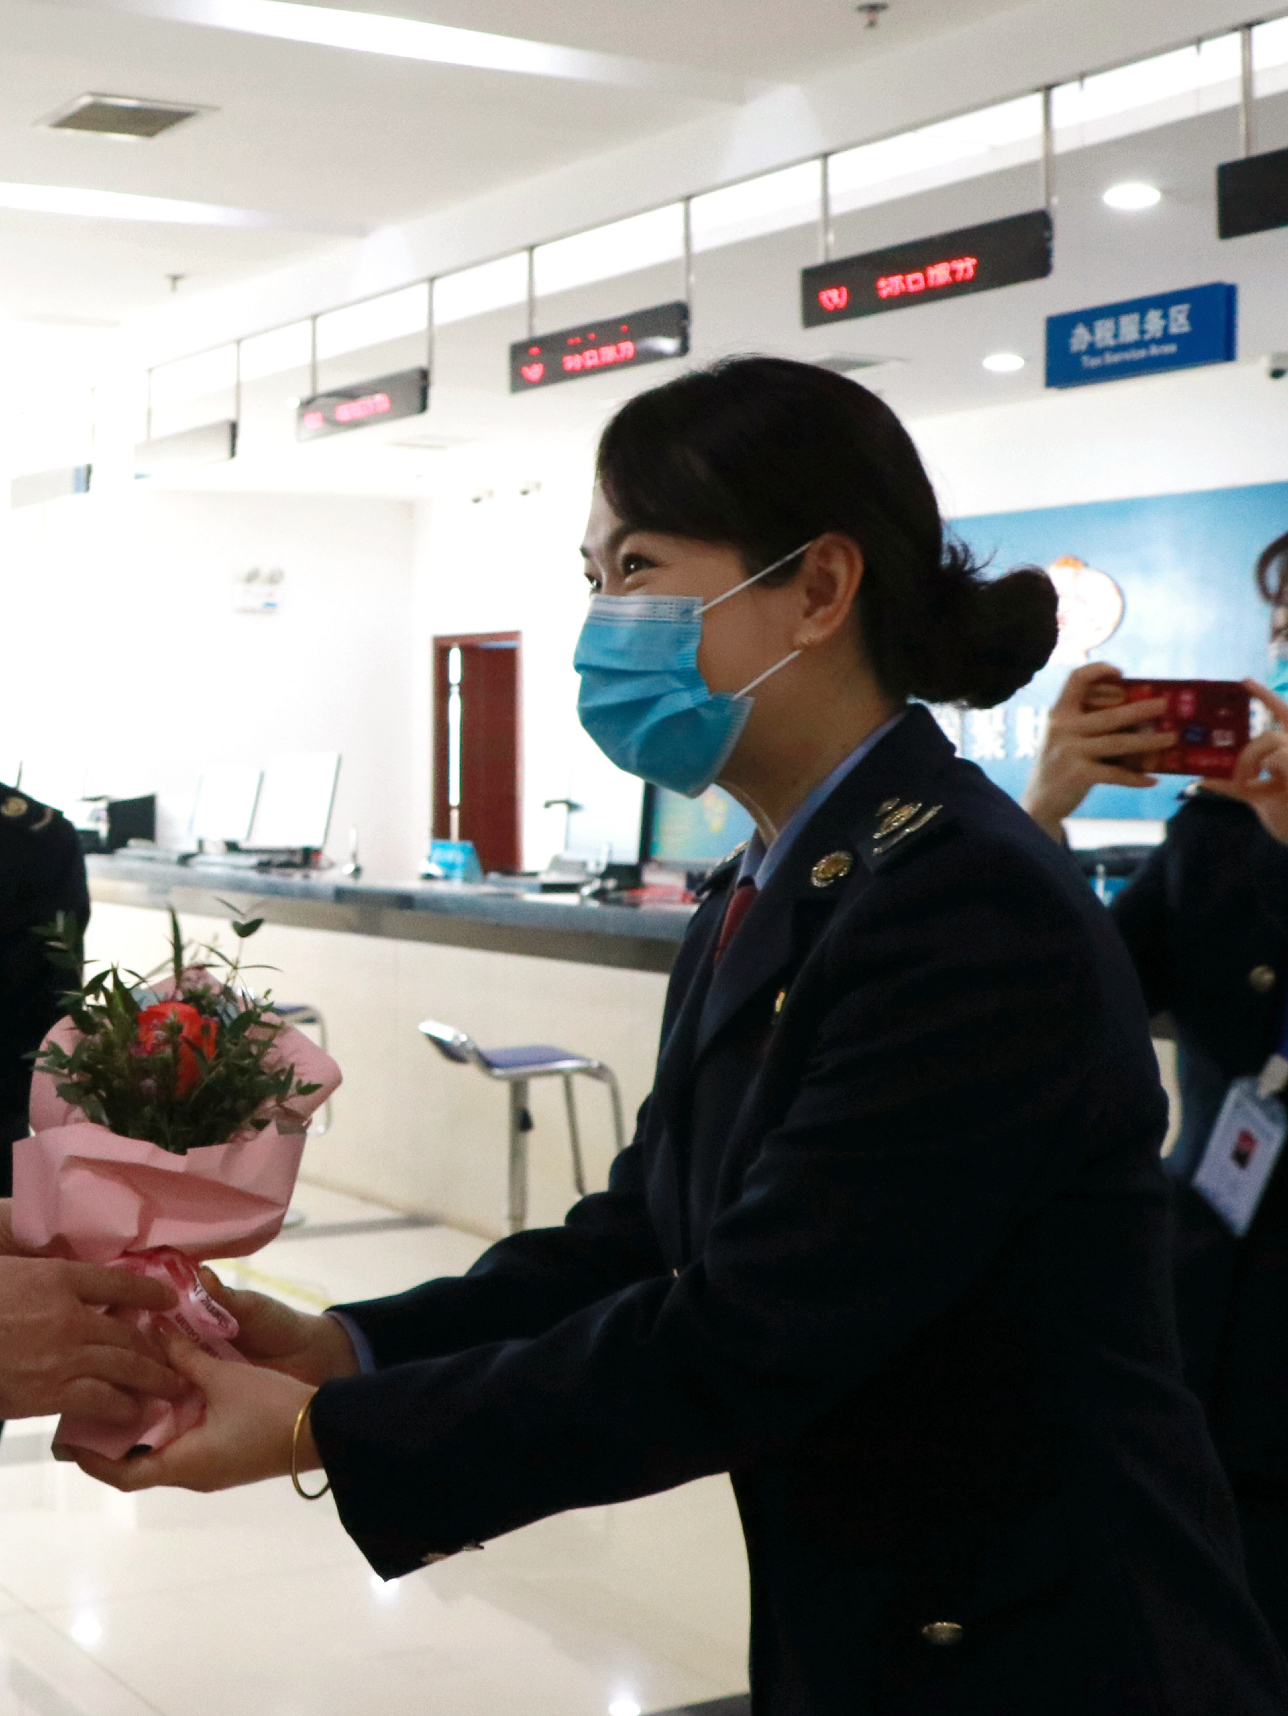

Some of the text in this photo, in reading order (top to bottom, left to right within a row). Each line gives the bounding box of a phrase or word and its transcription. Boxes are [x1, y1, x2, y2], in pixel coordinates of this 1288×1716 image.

[1070, 304, 1191, 352] 办税服务区
[1080, 354, 1102, 369] Tax
[1104, 348, 1147, 364] Service
